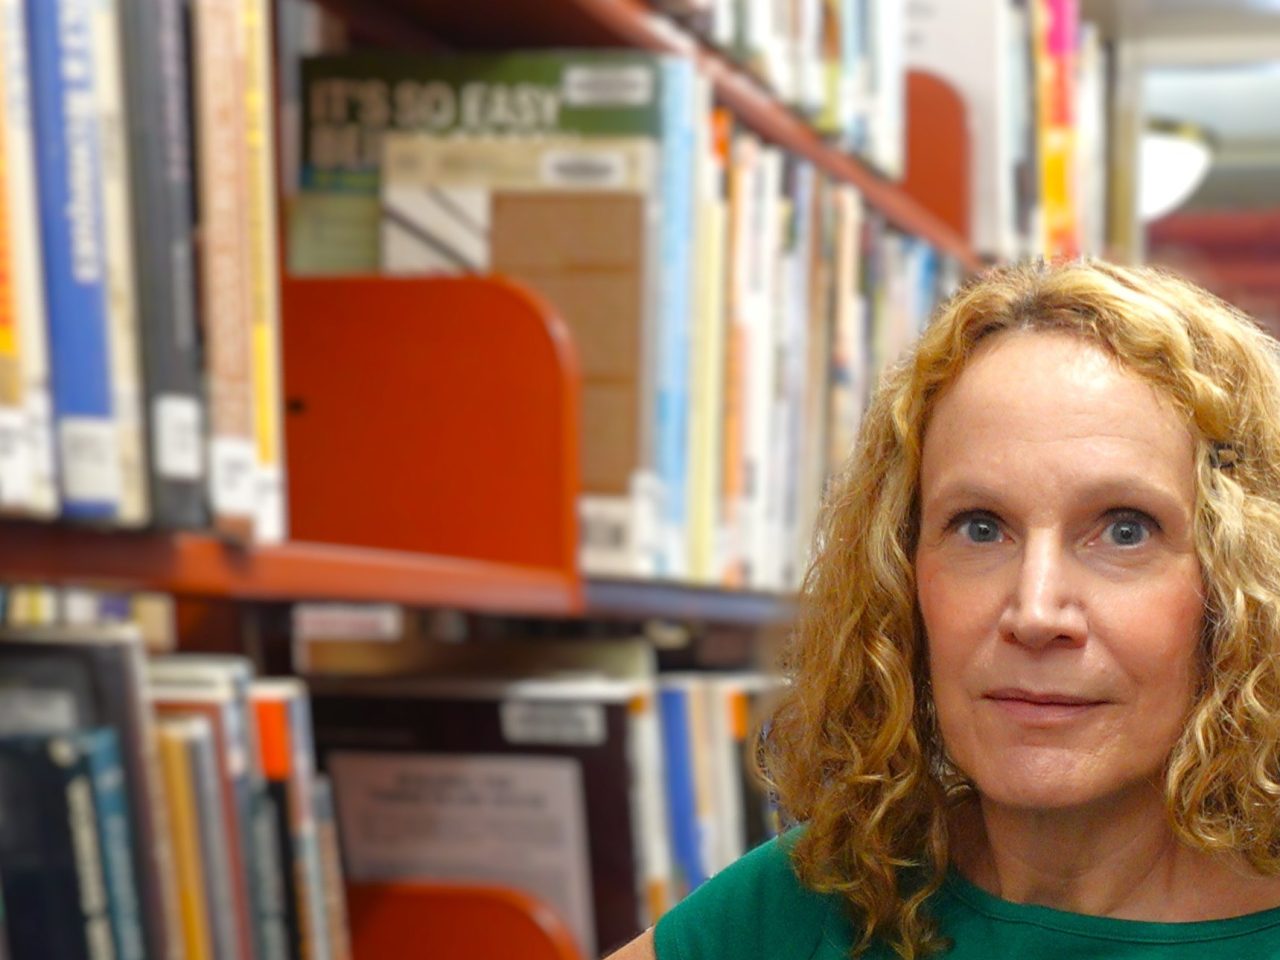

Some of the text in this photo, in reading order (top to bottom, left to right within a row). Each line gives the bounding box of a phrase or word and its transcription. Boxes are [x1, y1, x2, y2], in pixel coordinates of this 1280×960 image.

[310, 77, 390, 126] IT'S
[395, 80, 456, 129] SO
[460, 82, 561, 131] EASY
